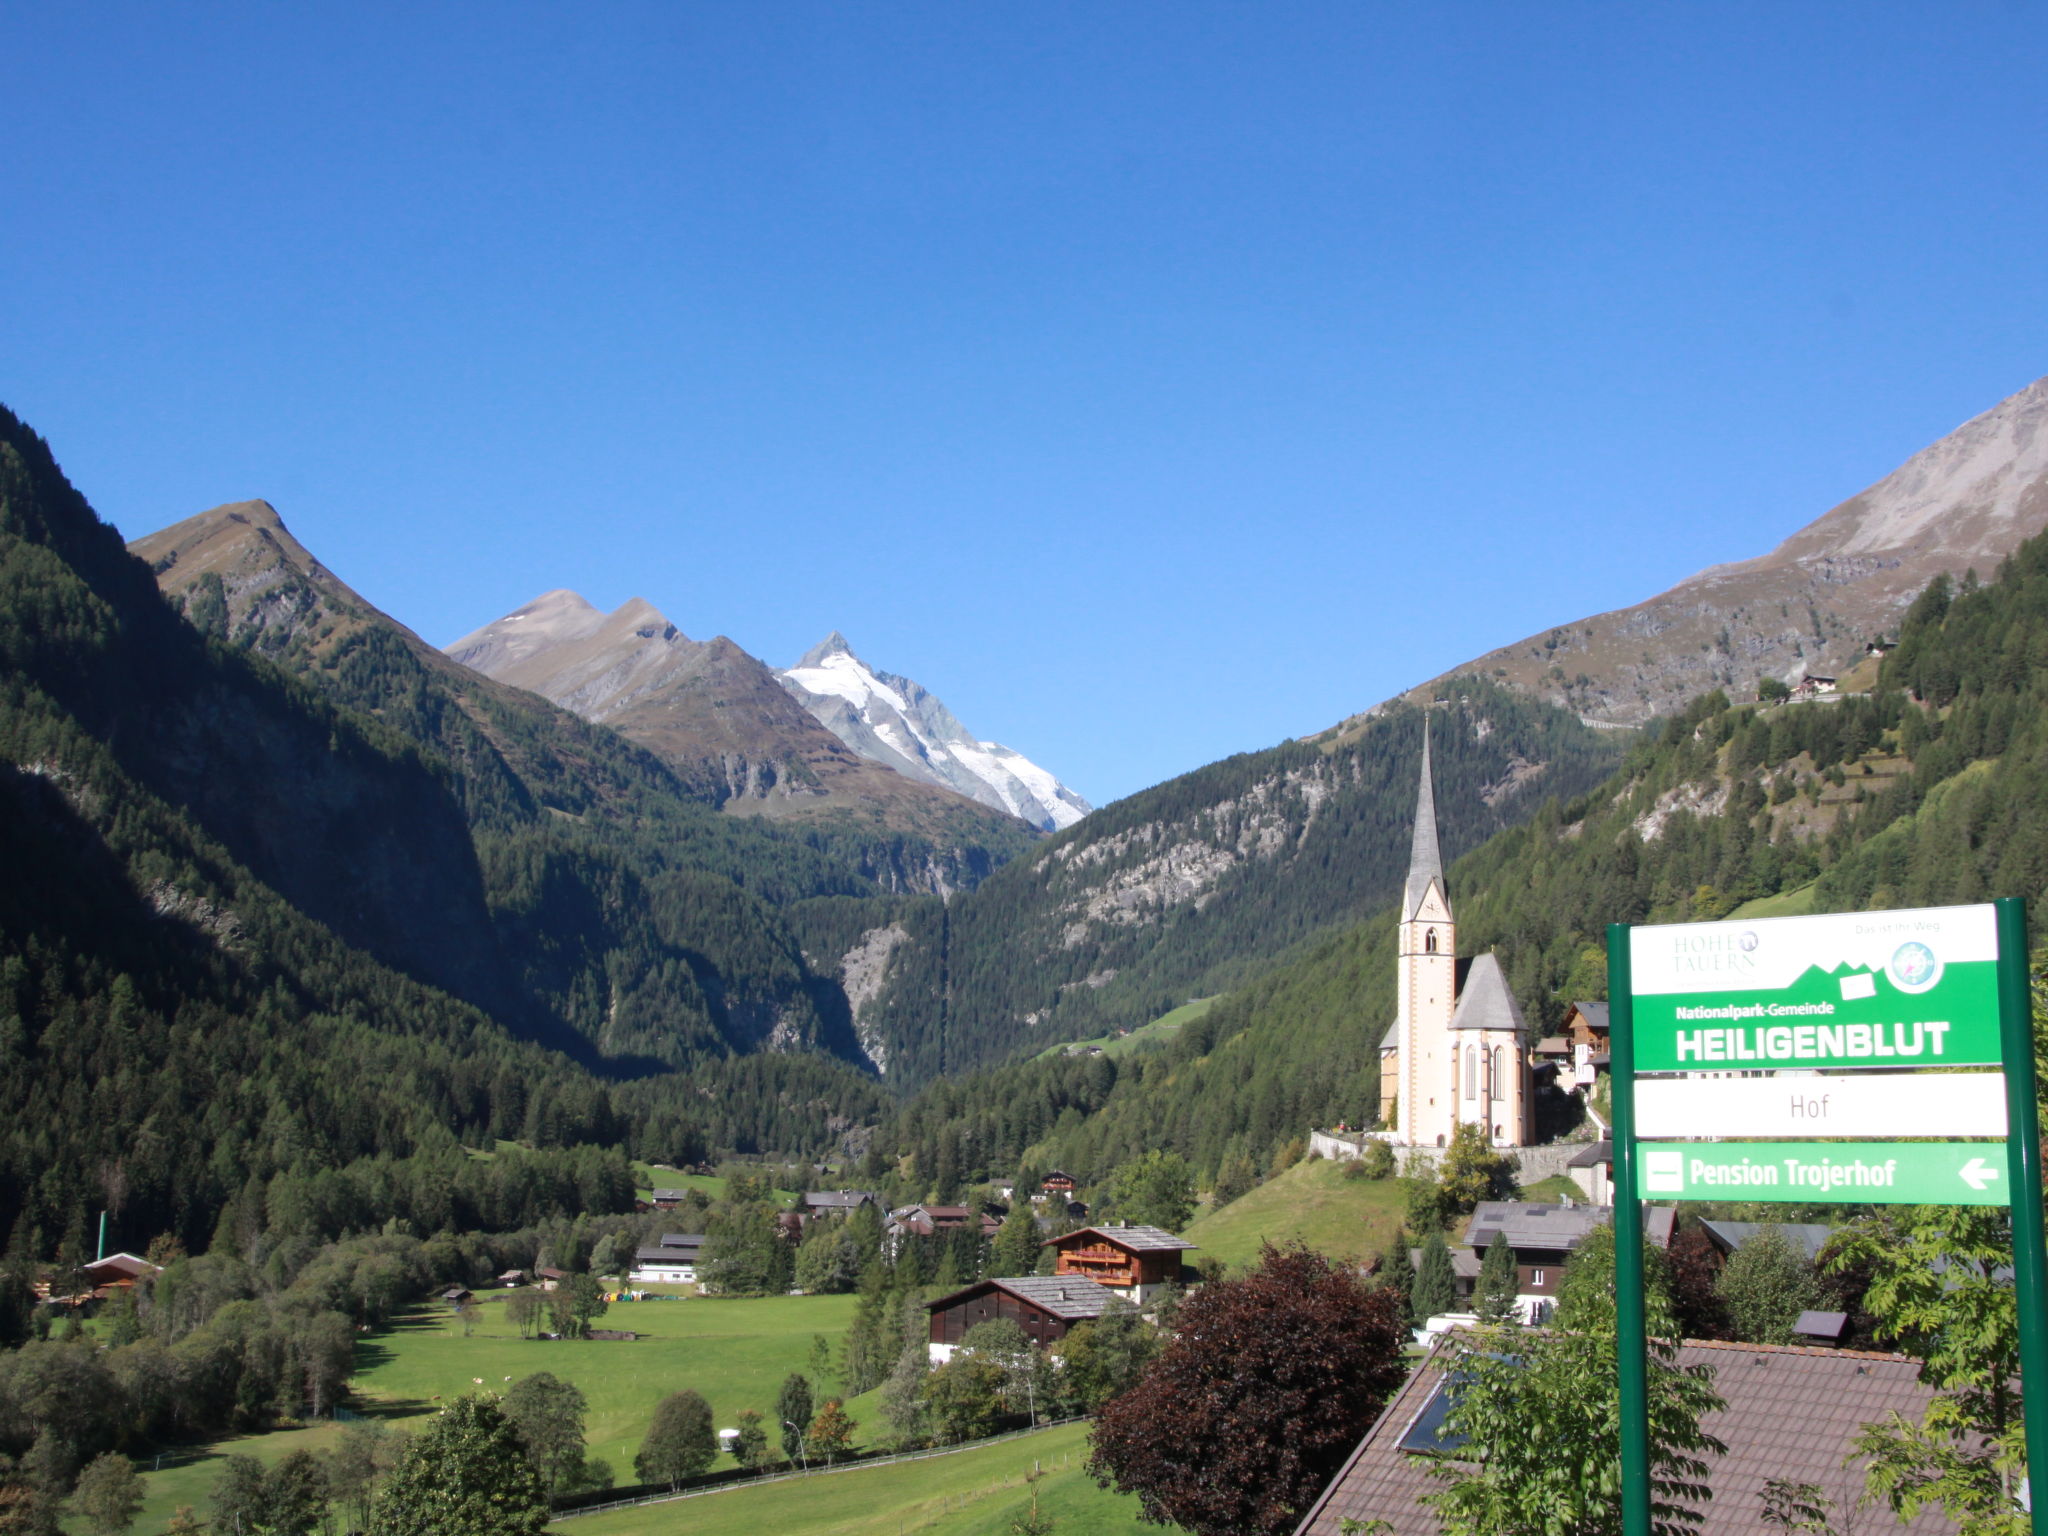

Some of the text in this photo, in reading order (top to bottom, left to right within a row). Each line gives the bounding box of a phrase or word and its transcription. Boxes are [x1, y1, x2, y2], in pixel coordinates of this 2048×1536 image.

[1856, 924, 1875, 935] Das
[1879, 923, 1891, 935] ist
[1895, 922, 1910, 933] Ihr
[1672, 951, 1756, 973] TAUERN
[1676, 1001, 1835, 1020] Nationalpark-Gemeinde
[1676, 1021, 1950, 1061] HEILIGENBLUT
[1790, 1094, 1829, 1118] Hof
[1690, 1159, 1897, 1191] Pension Trojerhof
